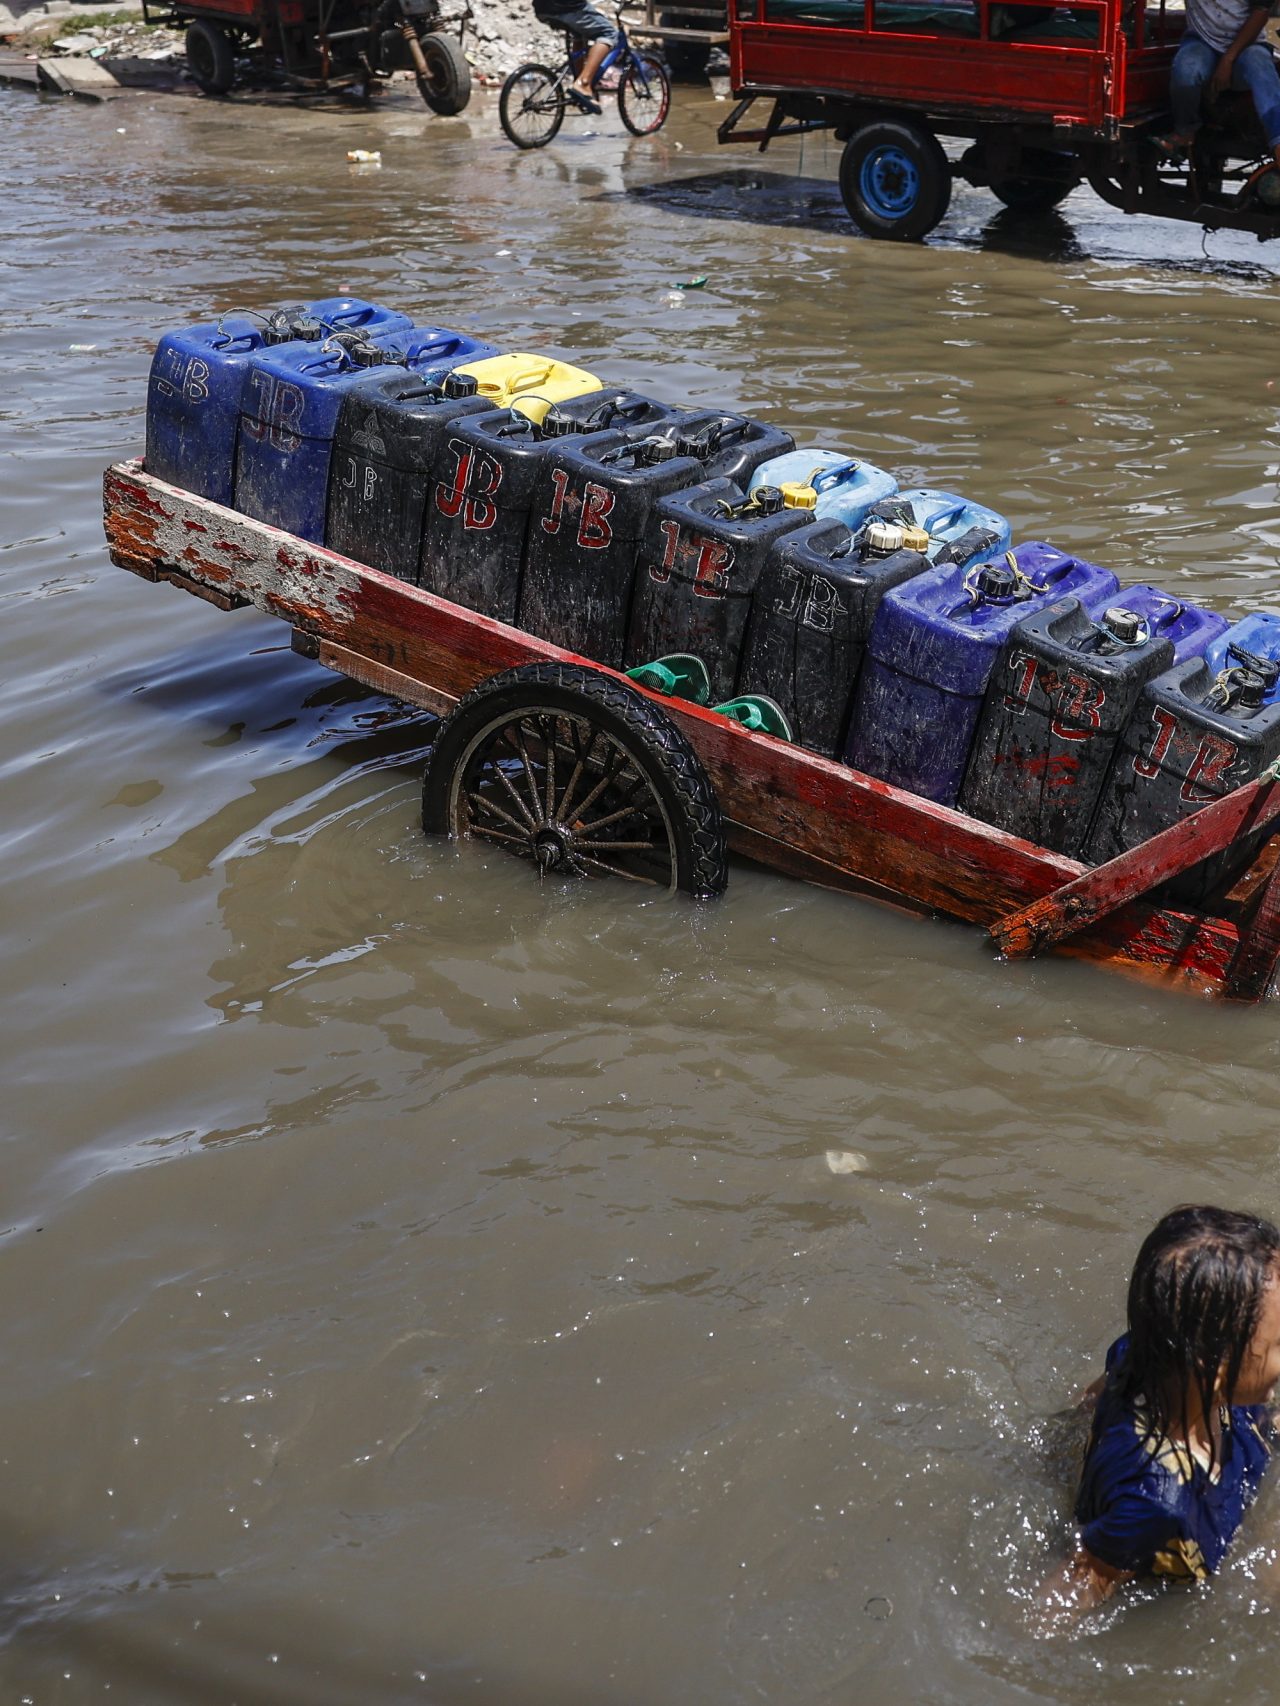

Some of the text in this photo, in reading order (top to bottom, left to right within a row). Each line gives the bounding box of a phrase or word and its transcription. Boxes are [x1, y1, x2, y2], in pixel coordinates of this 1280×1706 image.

[241, 369, 304, 453] JB
[342, 457, 378, 501] JB
[435, 438, 503, 530] JB
[541, 468, 616, 549] JB
